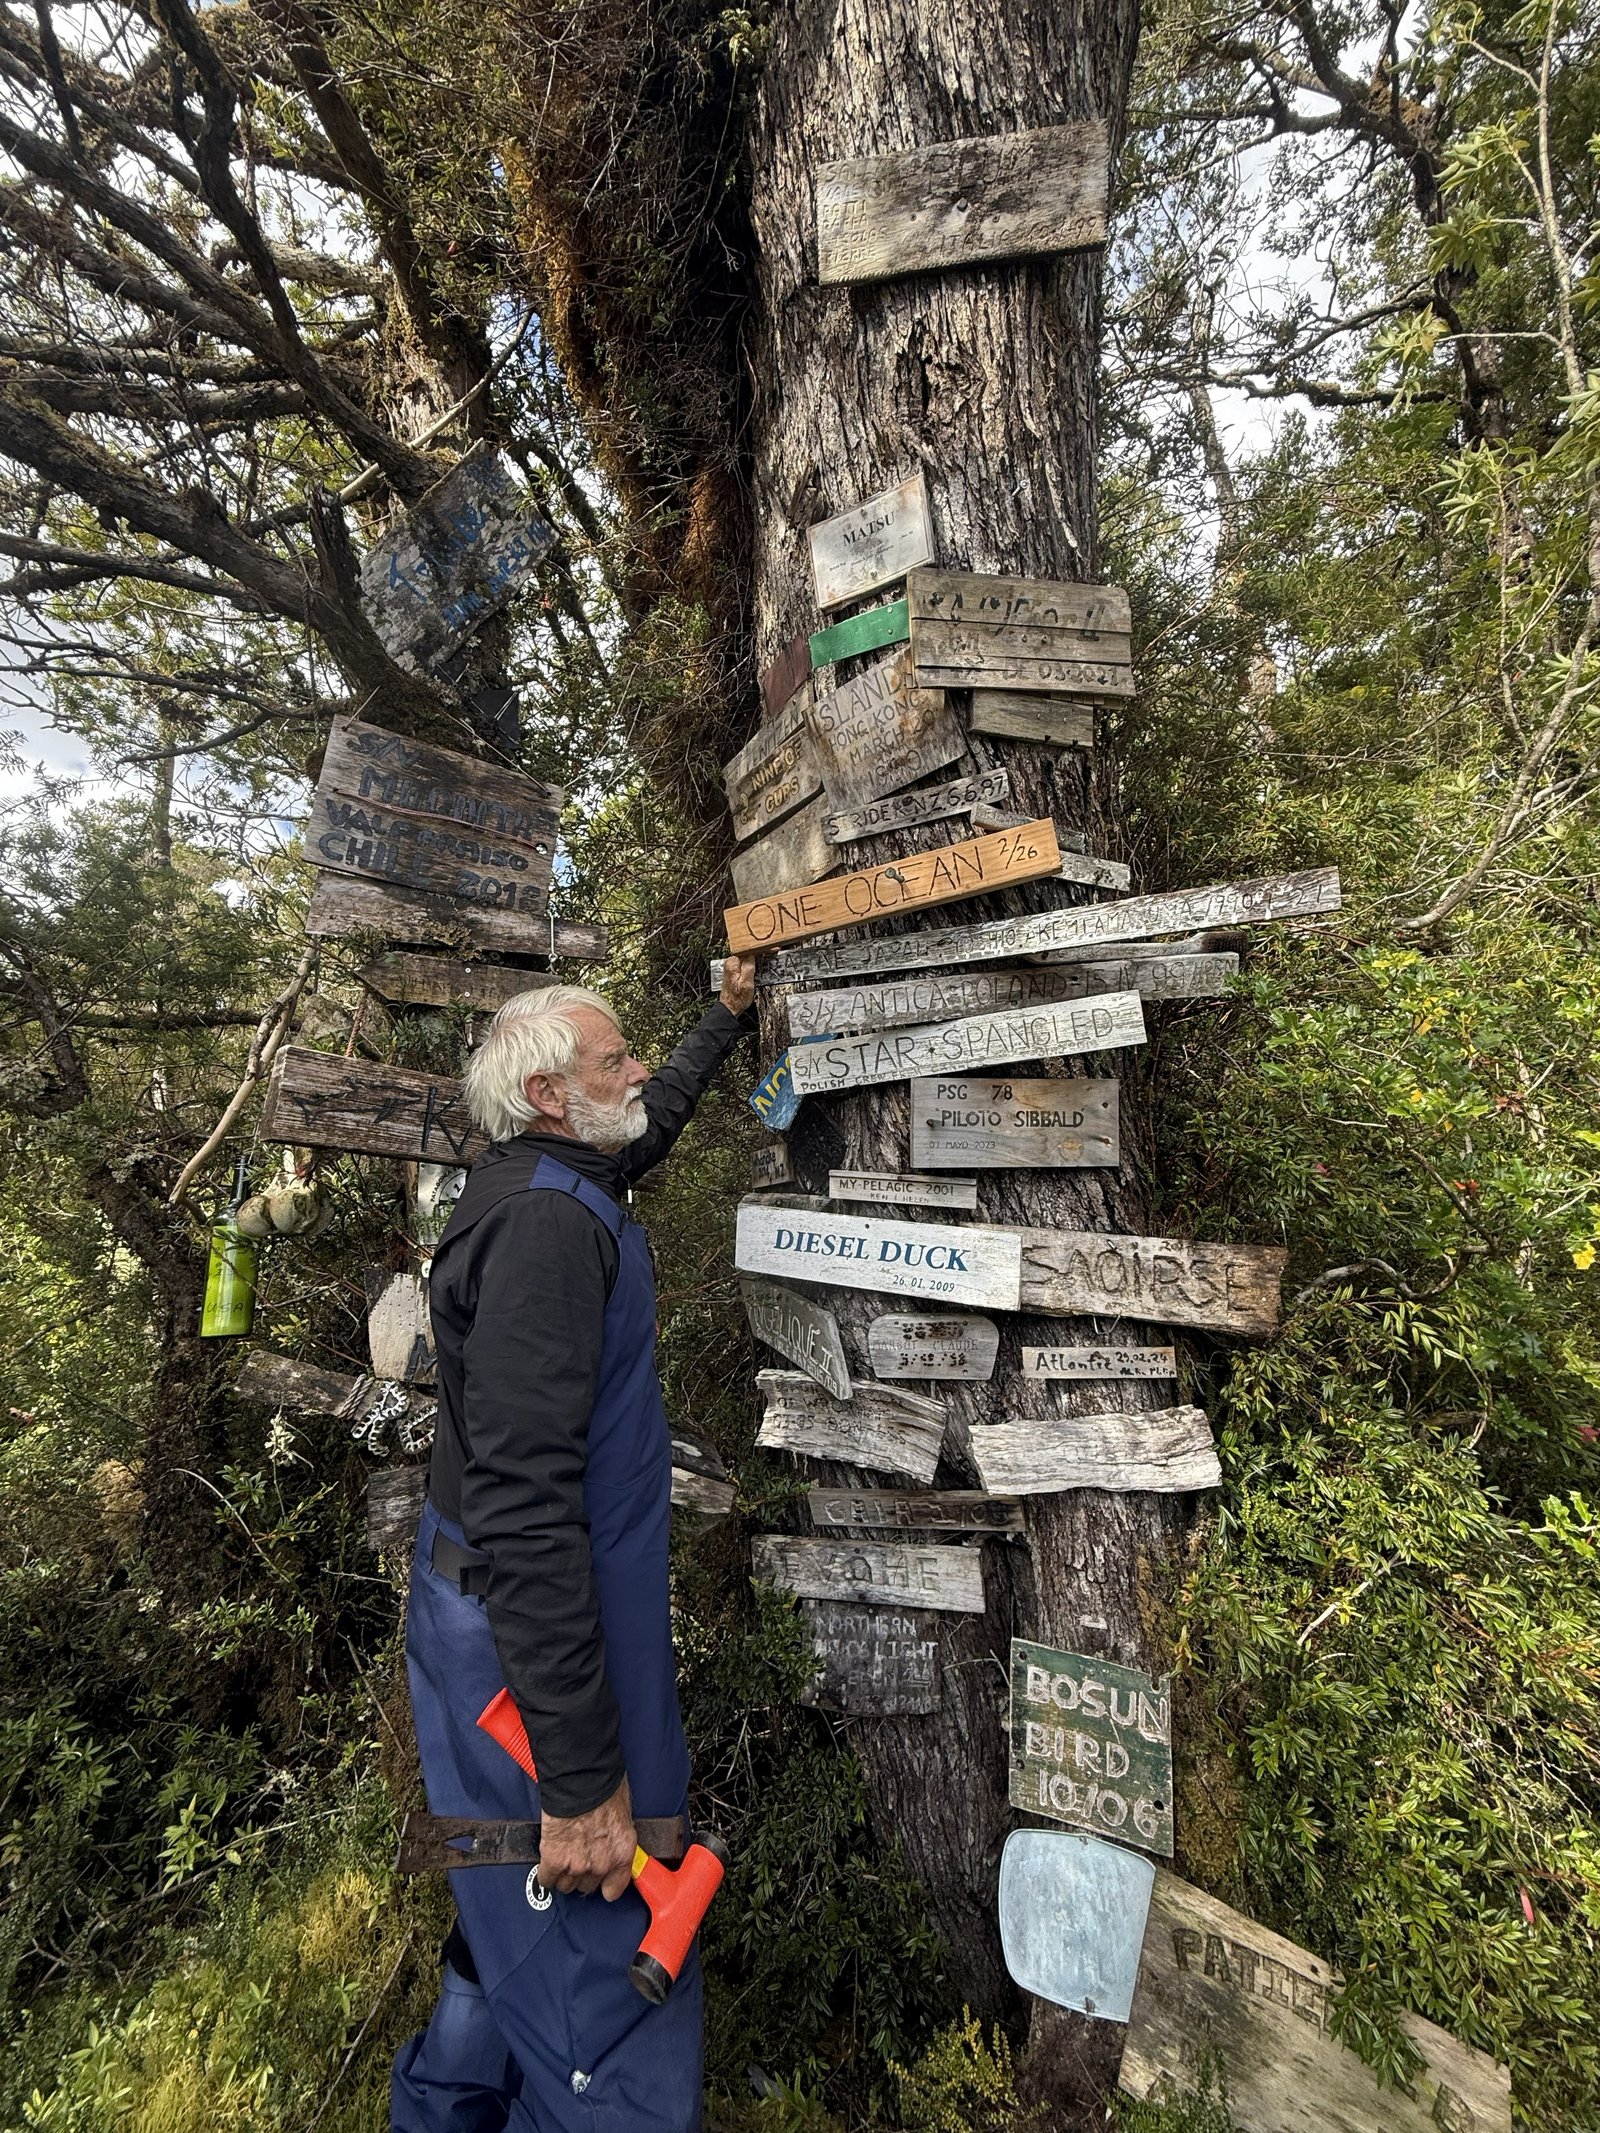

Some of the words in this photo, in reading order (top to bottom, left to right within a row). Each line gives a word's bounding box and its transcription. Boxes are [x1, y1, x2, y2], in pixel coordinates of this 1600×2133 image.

[842, 511, 896, 547] MATSU
[849, 727, 906, 767] MARCH
[751, 755, 783, 791] NINE
[867, 750, 922, 786] 190
[764, 778, 801, 815] CUPS
[746, 894, 822, 942] ONE
[844, 846, 985, 917] OCEAN
[997, 834, 1038, 870] 2/26
[826, 1036, 918, 1079] STAR
[941, 1008, 1114, 1060] SPANGLED
[800, 1078, 845, 1094] POLISH
[937, 1085, 968, 1100] PSG
[992, 1085, 1013, 1100] 78
[774, 1229, 870, 1261] DIESEL
[878, 1240, 971, 1272] DUCK
[206, 1301, 244, 1313] USA
[1026, 1666, 1170, 1743] BOSUN
[1025, 1721, 1130, 1779] BIRD
